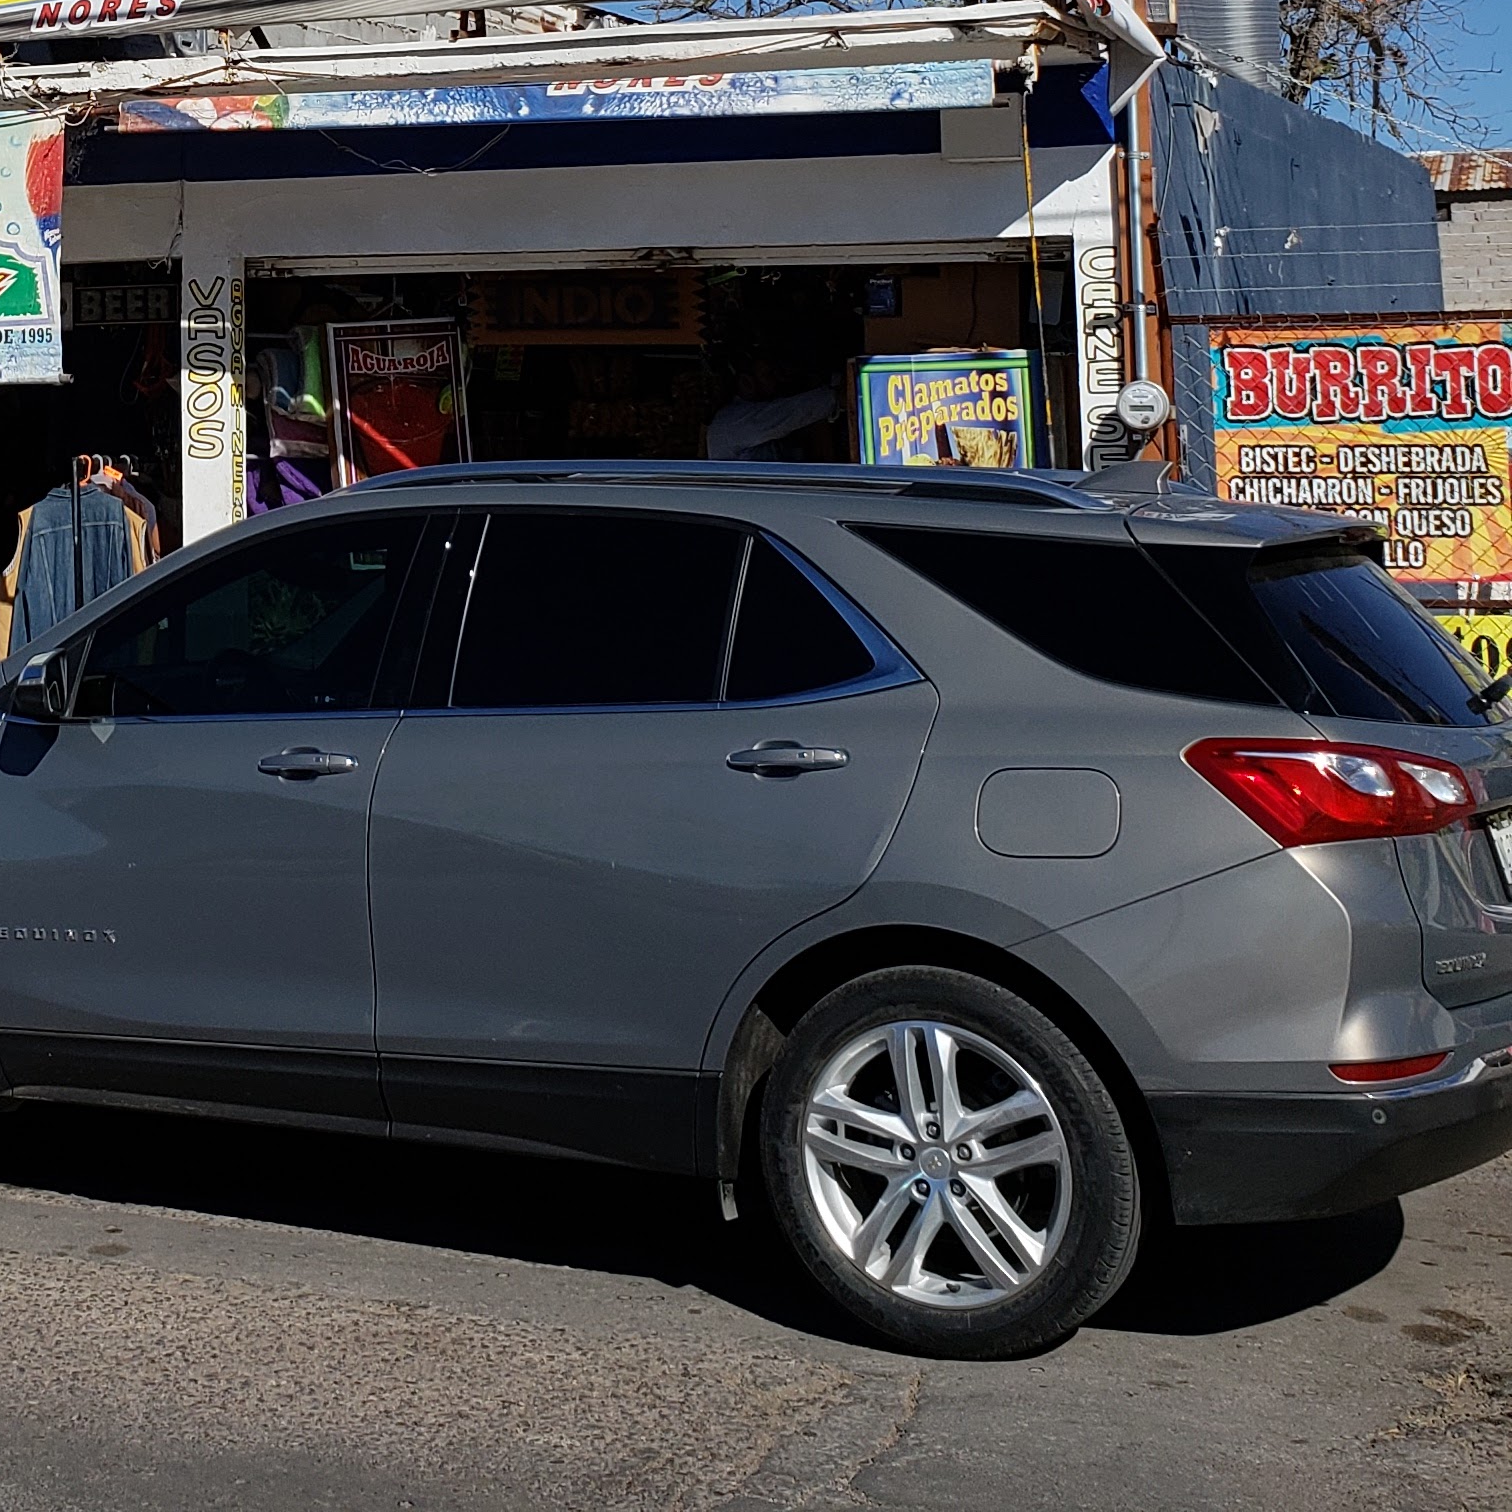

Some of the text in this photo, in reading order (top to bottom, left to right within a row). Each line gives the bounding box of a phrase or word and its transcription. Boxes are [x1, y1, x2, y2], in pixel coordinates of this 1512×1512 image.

[80, 288, 170, 322] BEER
[515, 284, 654, 328] INDIO
[1079, 246, 1125, 394] CARNE
[20, 326, 53, 344] 1995
[187, 276, 225, 459] VASOS
[349, 341, 448, 373] AGUA ROJA
[888, 370, 1008, 414] Clamatos
[879, 390, 1018, 456] Preparados
[1240, 446, 1316, 473] BISTEC
[1338, 446, 1486, 472] DESHEBRADA
[1231, 475, 1372, 504] CHICHARRÓN
[1397, 477, 1502, 504] FRIJOLES
[1397, 509, 1470, 536] QUESO
